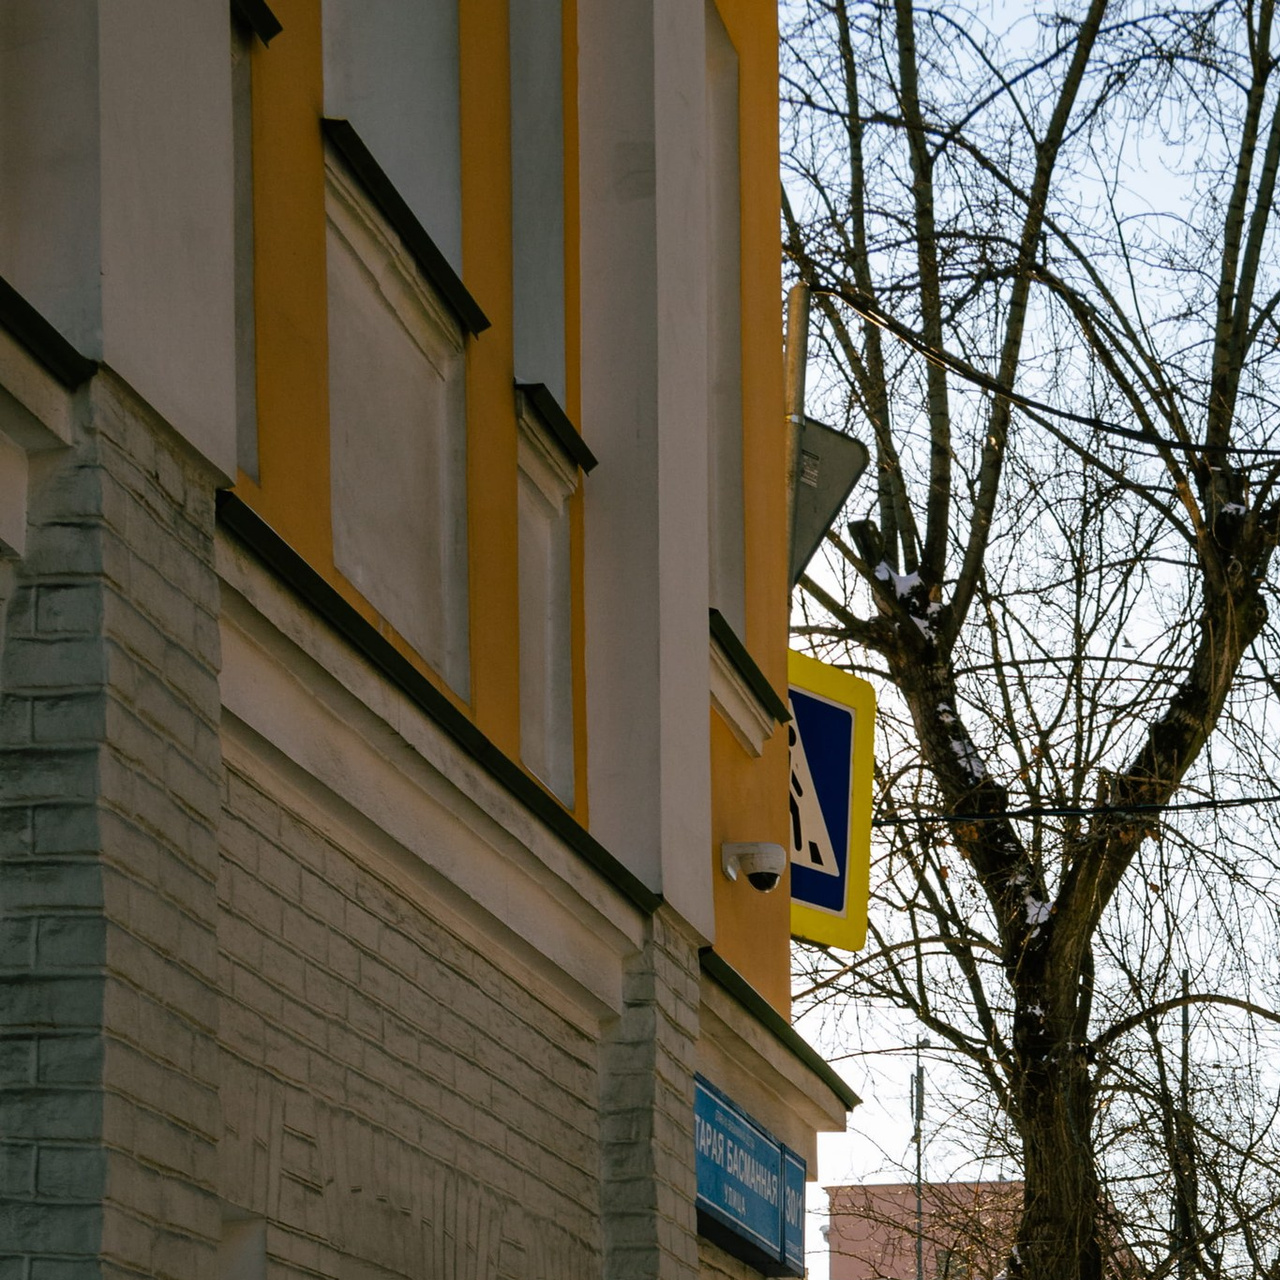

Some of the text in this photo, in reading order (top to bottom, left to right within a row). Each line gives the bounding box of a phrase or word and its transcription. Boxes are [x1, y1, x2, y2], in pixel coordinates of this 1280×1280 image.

[695, 1113, 725, 1168] ТАРАЯ
[727, 1140, 778, 1207] БАСМАННАЯ
[785, 1185, 802, 1230] 30/1
